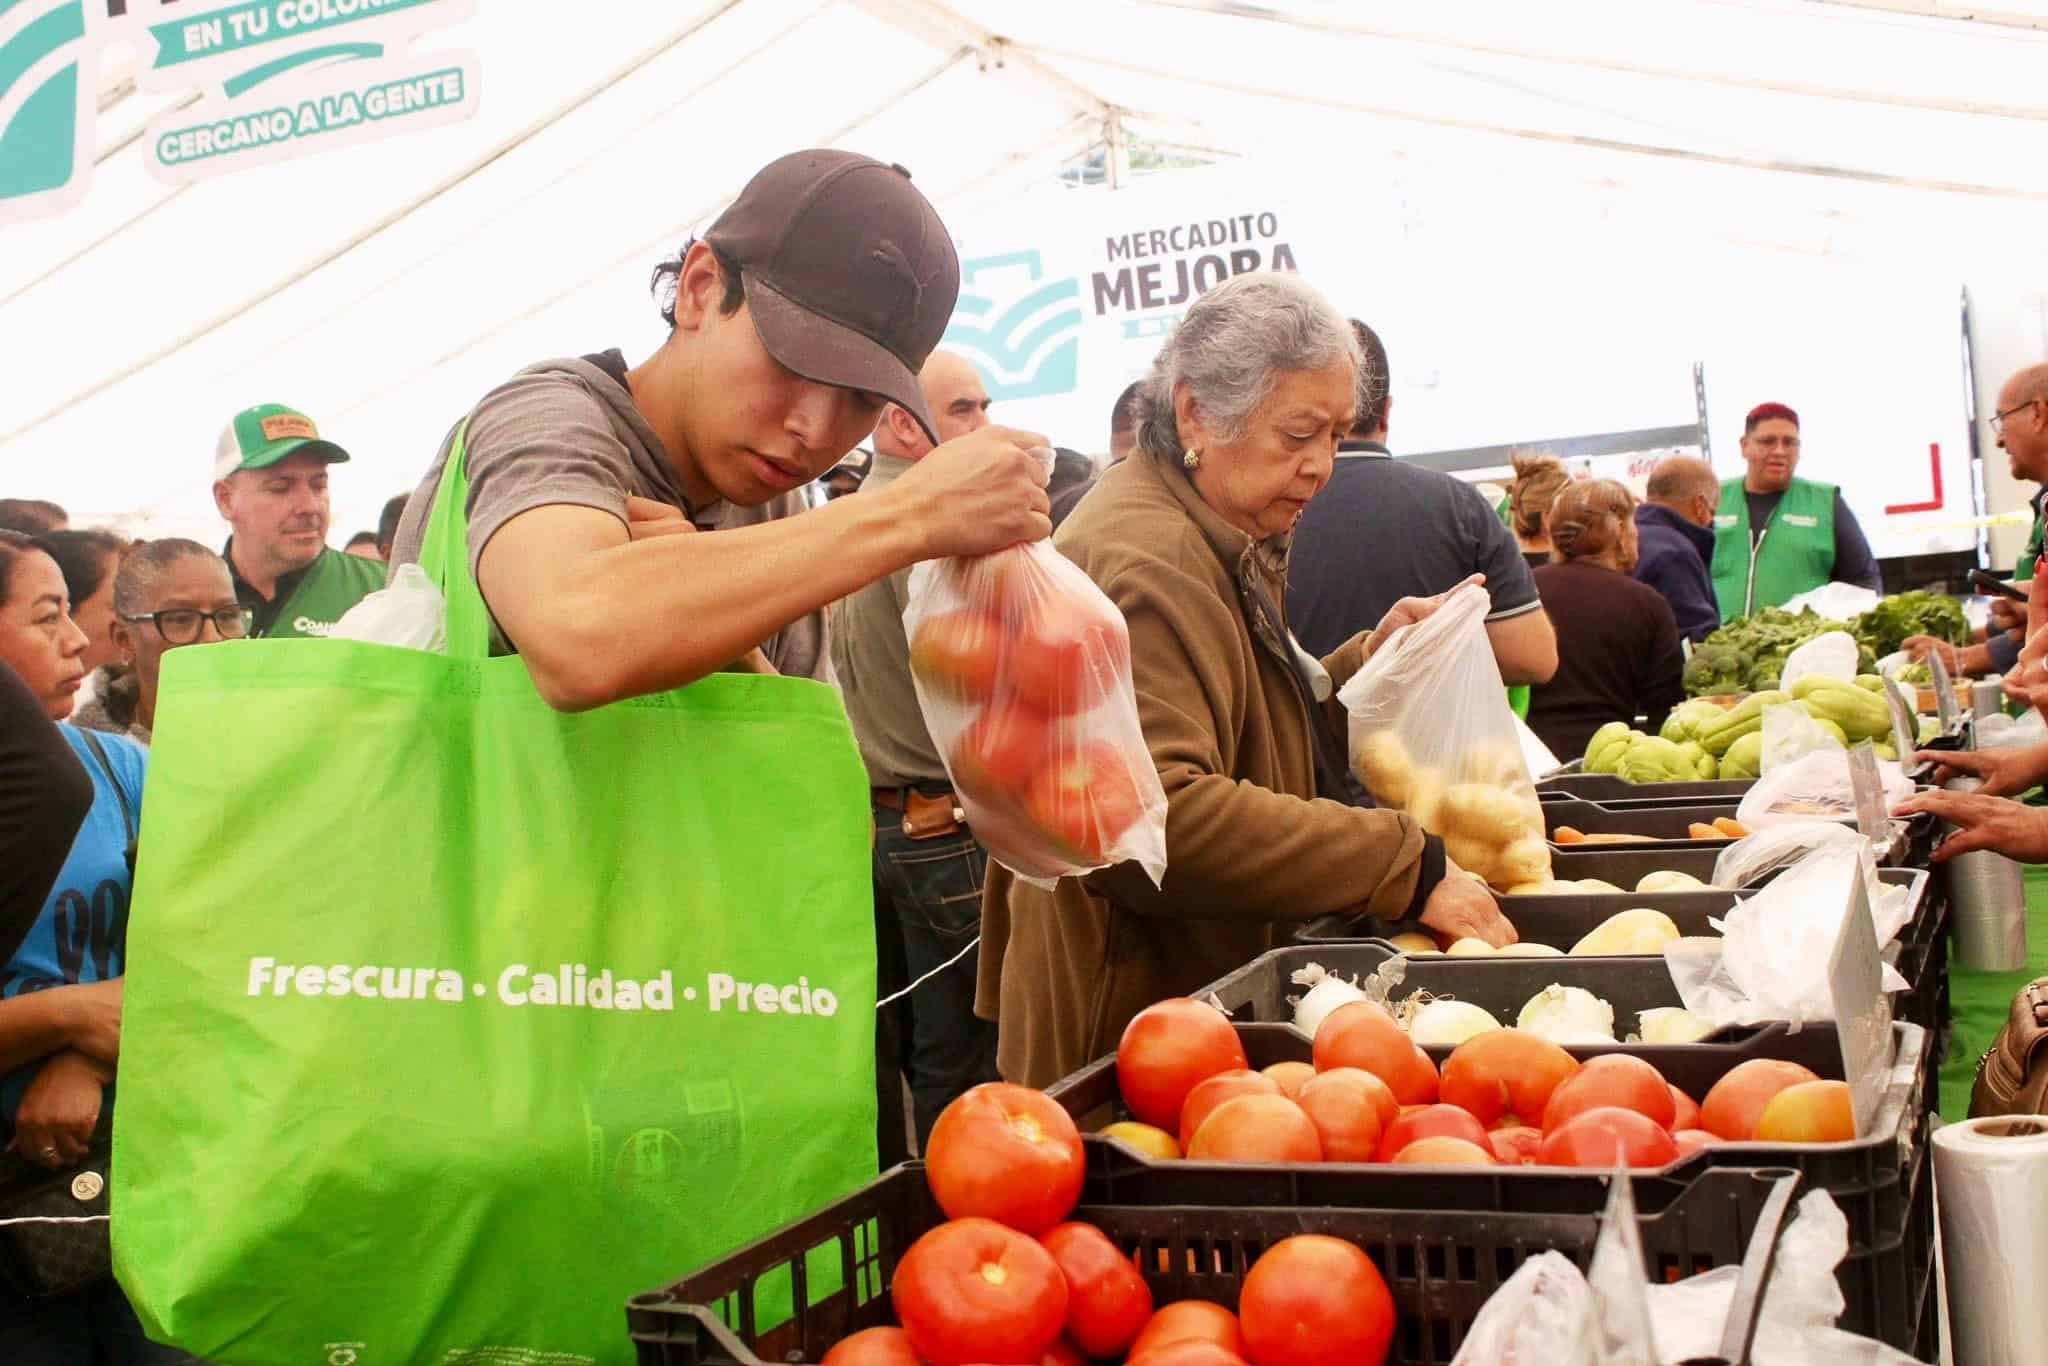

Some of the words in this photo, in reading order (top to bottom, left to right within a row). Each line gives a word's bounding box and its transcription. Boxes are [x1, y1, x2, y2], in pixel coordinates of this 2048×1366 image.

[183, 18, 223, 52] EN
[228, 7, 269, 41] TU
[276, 0, 394, 30] COLO
[159, 110, 293, 162] CERCANO
[298, 102, 321, 133] A
[322, 96, 362, 128] LA
[365, 76, 462, 117] GENTE
[1106, 211, 1278, 262] MERCADITO
[248, 956, 464, 1003] Frescura
[498, 963, 674, 1011] Calidad
[707, 971, 839, 1017] Precio
